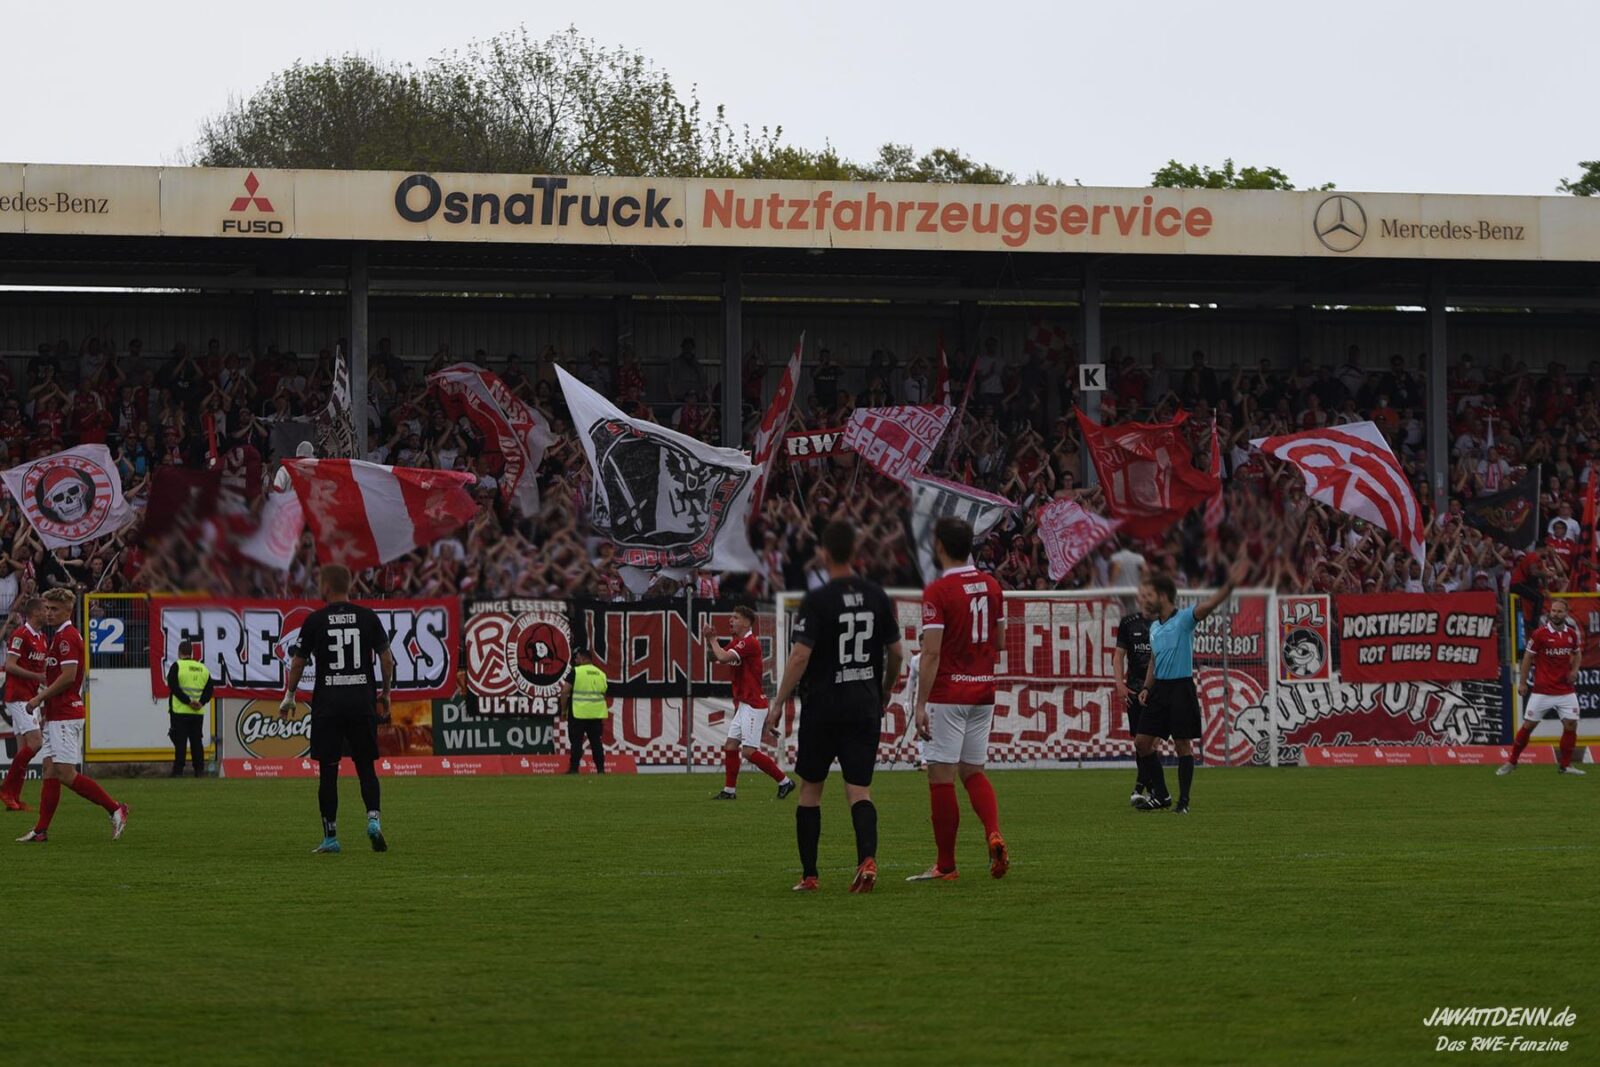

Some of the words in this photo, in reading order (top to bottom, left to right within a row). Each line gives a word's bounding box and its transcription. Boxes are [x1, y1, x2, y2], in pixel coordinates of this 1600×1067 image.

[0, 192, 109, 213] edes-Benz
[394, 174, 683, 228] OsnaTruck.
[702, 188, 1213, 248] Nutzfahrzeugservice
[222, 219, 283, 234] FUSO
[1380, 219, 1525, 240] Mercedes-Benz
[1084, 368, 1099, 387] K
[469, 601, 509, 613] JUNGE
[512, 600, 567, 612] ESSENER
[1281, 602, 1325, 625] LPL
[969, 596, 989, 643] 11
[1343, 613, 1438, 638] NORTHSIDE
[1445, 615, 1494, 638] CREW
[98, 618, 124, 652] 2
[838, 611, 875, 664] 22
[1024, 602, 1126, 675] FANS
[163, 610, 448, 686] FREKS
[327, 627, 361, 670] 37
[1359, 645, 1386, 664] ROT
[1391, 643, 1432, 662] WEISS
[1436, 645, 1479, 664] ESSEN
[478, 696, 558, 715] ULTRAS
[442, 728, 501, 749] WILL
[506, 726, 553, 749] QUA
